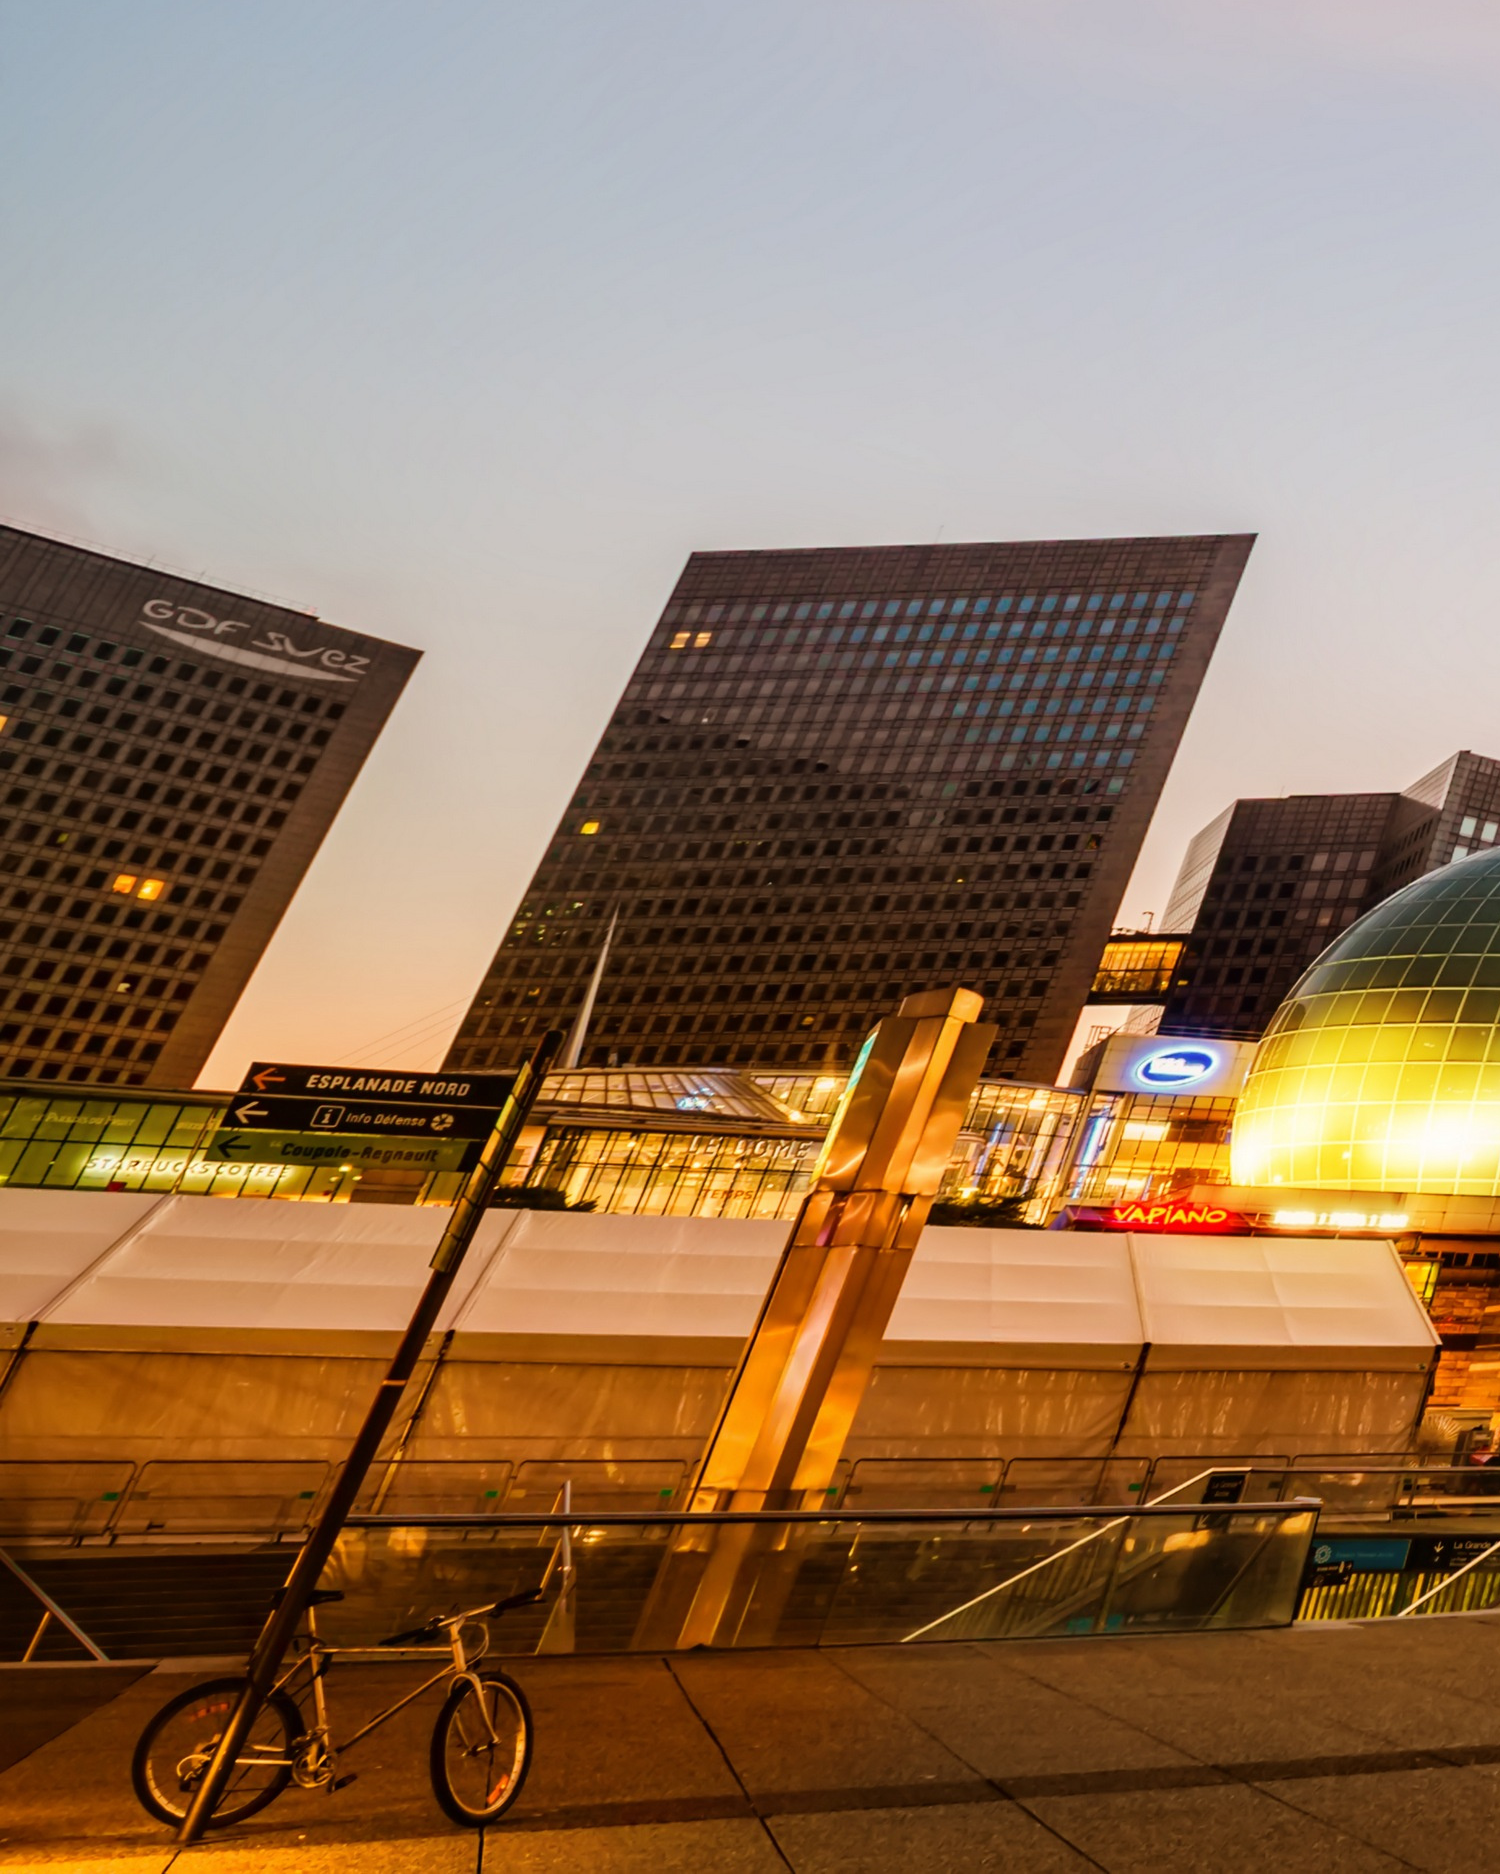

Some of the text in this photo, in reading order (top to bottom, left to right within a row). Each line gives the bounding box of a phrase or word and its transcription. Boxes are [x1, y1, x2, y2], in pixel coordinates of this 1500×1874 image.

[143, 599, 250, 635] GDF
[306, 1074, 471, 1097] ESPLANADE NORD
[346, 1112, 372, 1124] Info
[374, 1113, 427, 1127] Défense
[280, 1141, 440, 1163] Coupole-Regnault
[86, 1157, 291, 1179] STARBUCKS COFFEE
[702, 1189, 754, 1201] TEMPS
[1453, 1541, 1463, 1549] La
